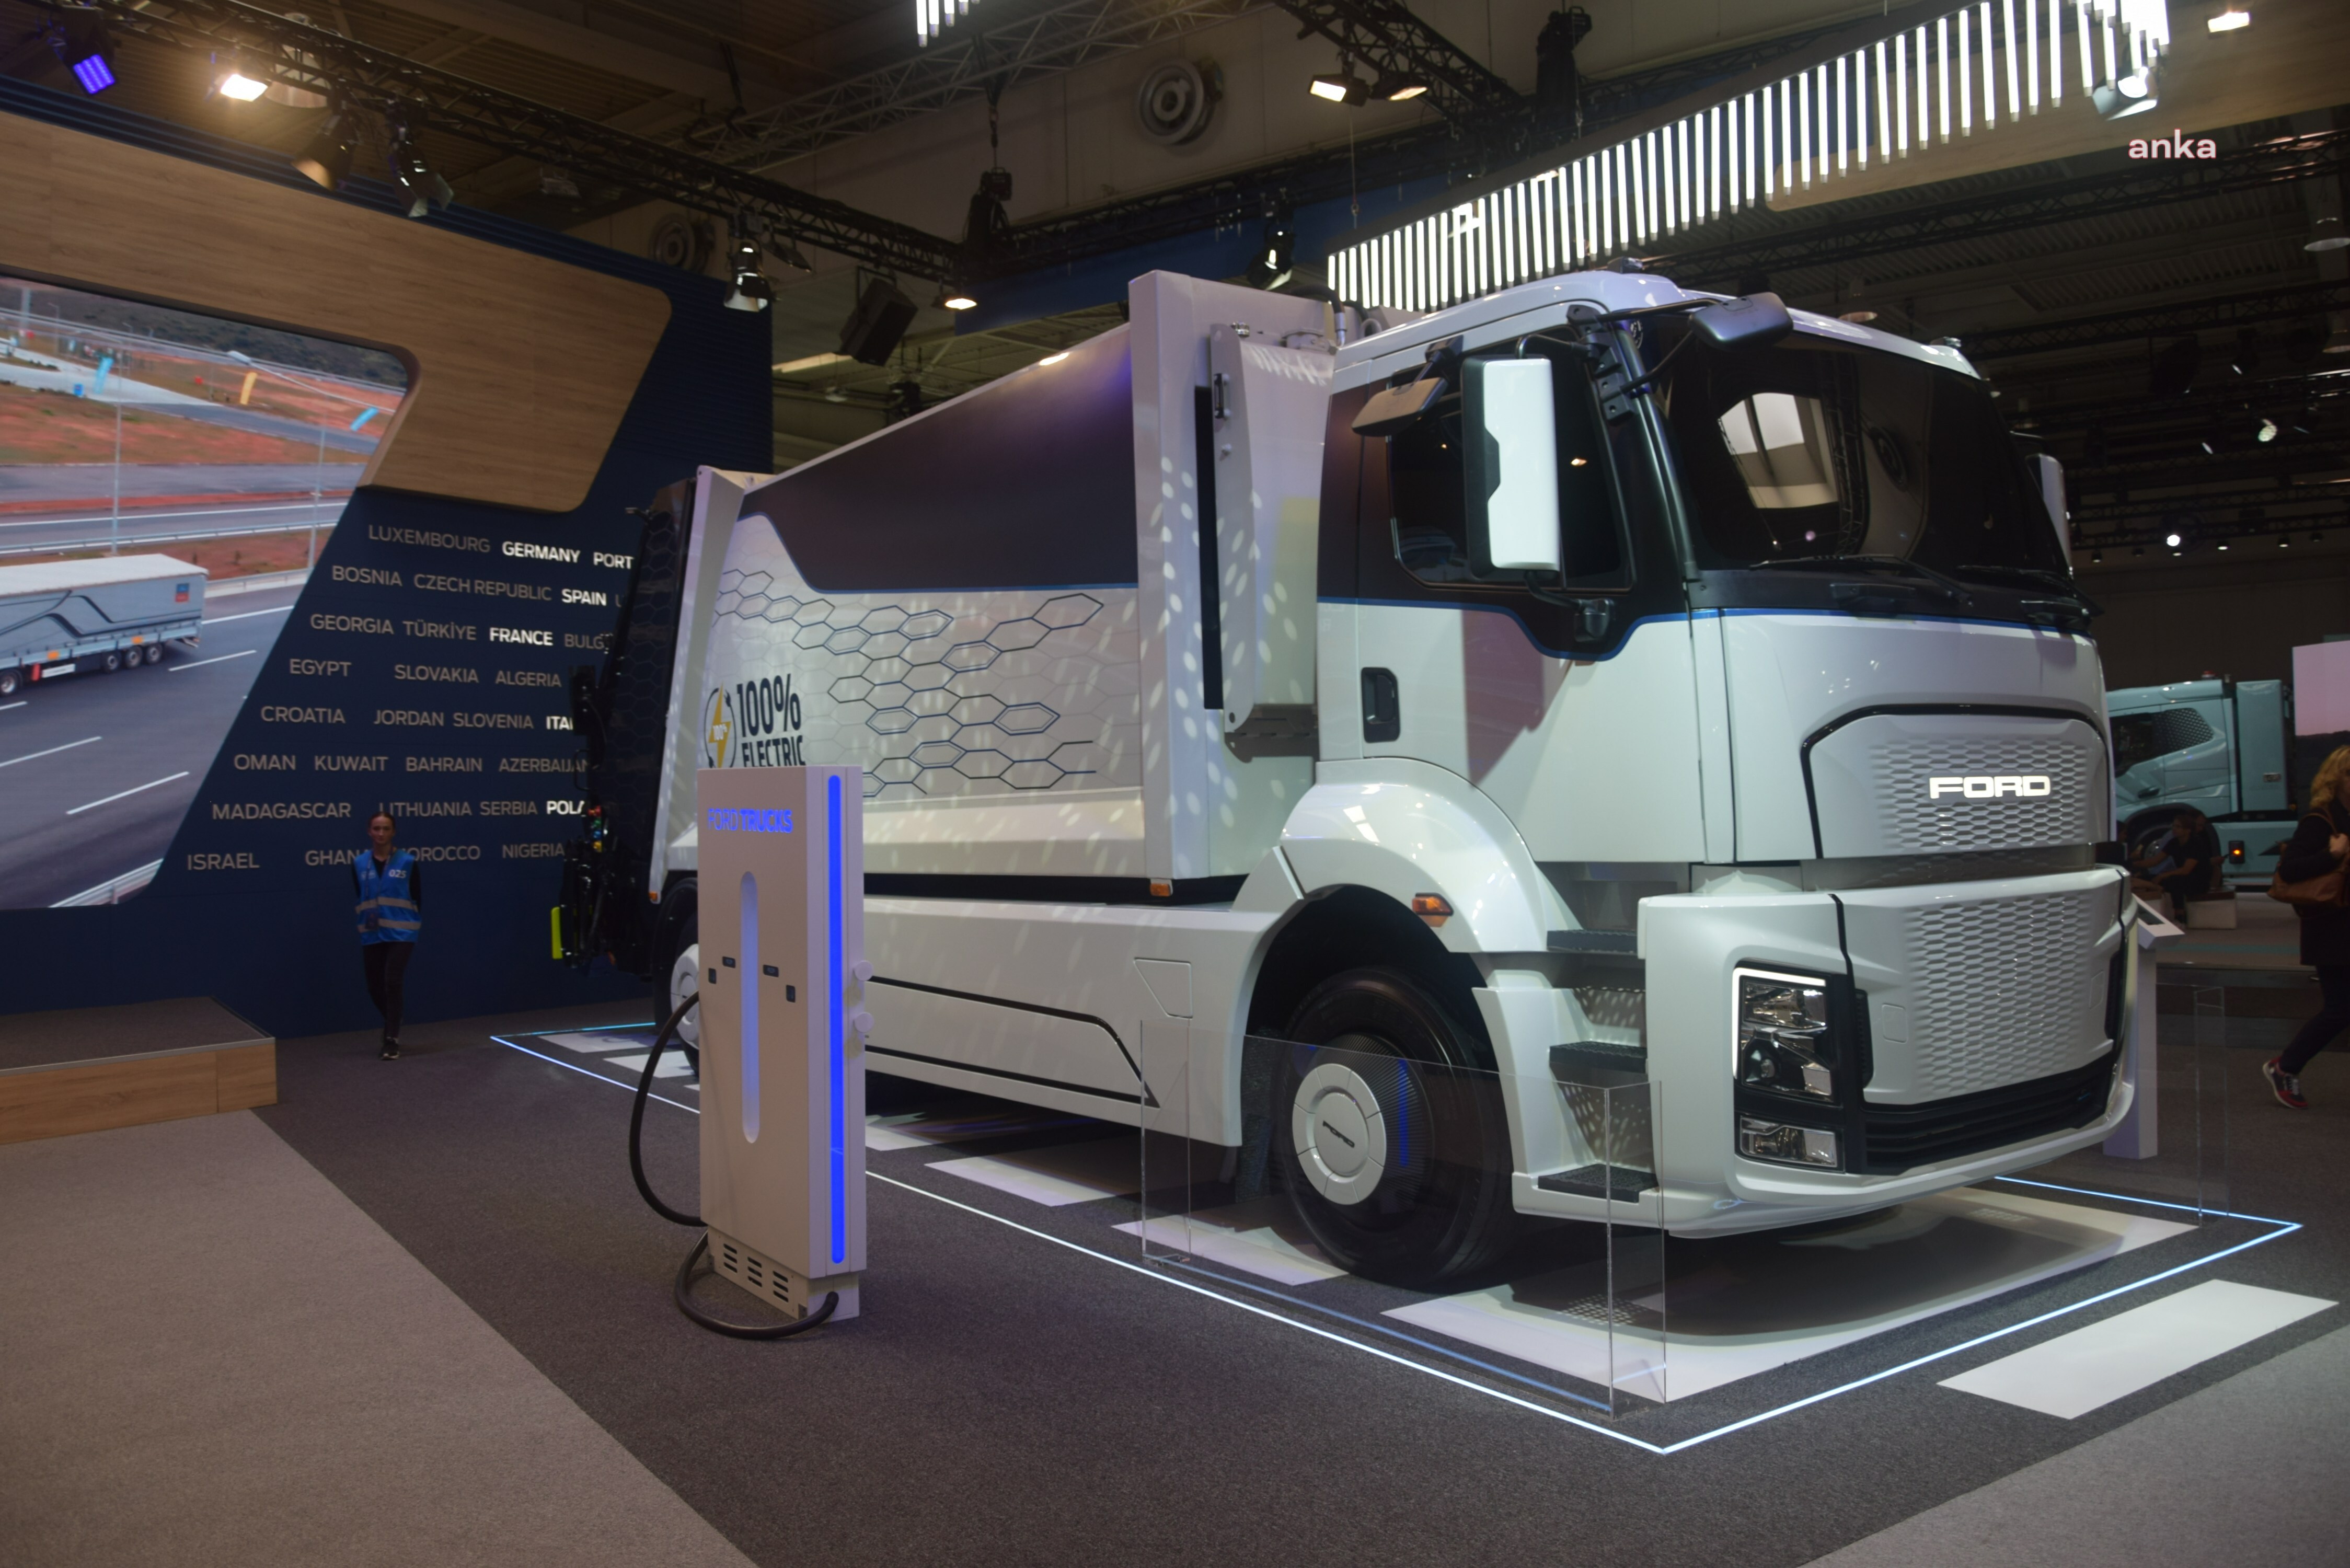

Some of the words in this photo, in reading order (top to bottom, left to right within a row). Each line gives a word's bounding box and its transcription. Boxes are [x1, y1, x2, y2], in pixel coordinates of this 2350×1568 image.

[368, 525, 490, 552] LUXEMBOURG
[502, 541, 580, 562] GERMANY
[332, 566, 402, 586] BOSNIA
[414, 574, 470, 593] CZECH
[474, 580, 551, 601] REPUBLIC
[562, 589, 606, 606] SPAIN
[310, 614, 394, 634] GEORGIA
[402, 619, 476, 640] TÜRKİYE
[490, 628, 552, 645] FRANCE
[290, 659, 351, 676] EGYPT
[395, 664, 478, 683] SLOVAKIA
[496, 671, 561, 687] ALGERIA
[261, 706, 345, 723] CROATIA
[374, 710, 443, 726] JORDAN
[453, 712, 533, 728] SLOVENIA
[736, 673, 801, 737] 100%
[234, 754, 295, 770] OMAN
[315, 756, 388, 770] KUWAIT
[406, 757, 482, 772] BAHRAIN
[1929, 776, 2050, 799] FORD
[213, 803, 351, 819] MADAGASCAR
[480, 801, 538, 815] SERBIA
[708, 808, 738, 831] FORD
[739, 808, 793, 833] TRUCKS
[188, 853, 259, 870] ISRAEL
[305, 850, 368, 866] GHAN
[402, 846, 481, 861] OROCCO
[502, 843, 565, 858] NIGERIA
[388, 869, 407, 879] 025
